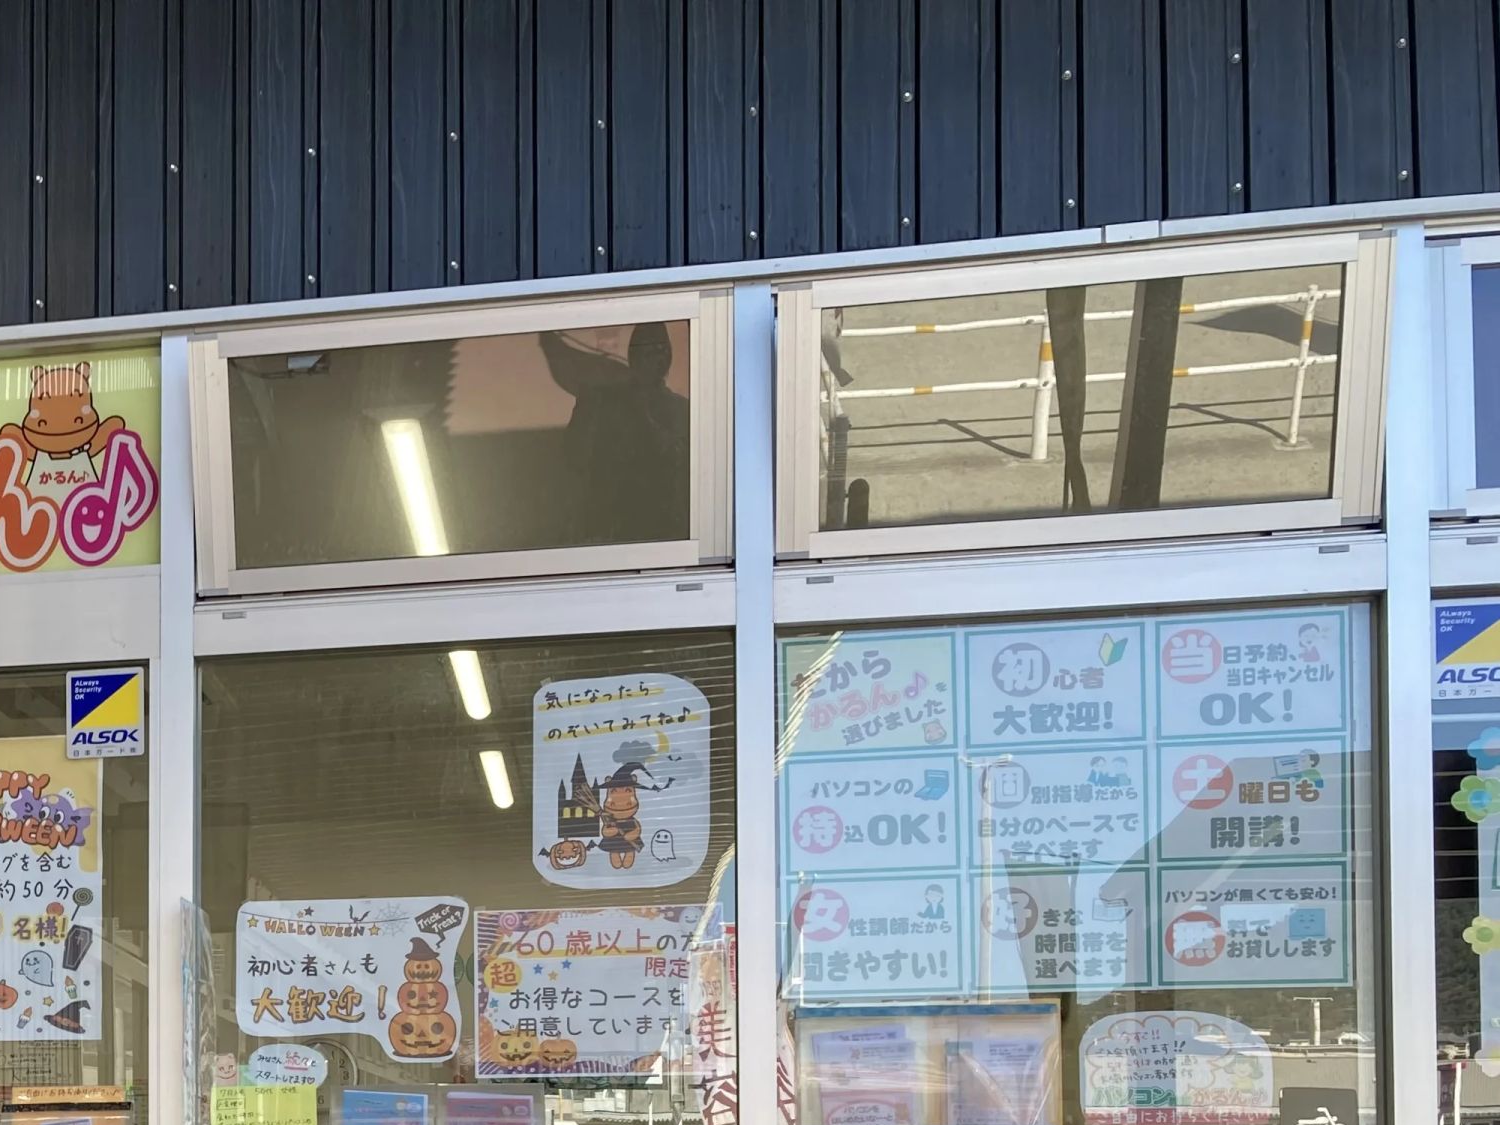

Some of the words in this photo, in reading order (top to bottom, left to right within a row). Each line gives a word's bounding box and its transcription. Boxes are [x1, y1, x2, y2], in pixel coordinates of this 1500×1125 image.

[1441, 617, 1475, 625] Security
[998, 649, 1104, 691] 初心者
[1227, 664, 1333, 687] 当日キャンセル
[545, 681, 651, 711] 気になったら
[993, 702, 1113, 736] 大歓迎!
[1200, 689, 1293, 727] OK!
[841, 700, 947, 745] 選びました
[72, 729, 139, 745] ALSOK
[811, 778, 913, 798] パソコンの
[977, 814, 1138, 837] 自分のペースで
[1210, 816, 1300, 849] 開講!
[1011, 839, 1103, 860] 学べます
[417, 911, 441, 929] Trick
[1034, 932, 1127, 953] 時間帯を
[1227, 938, 1336, 959] お貸しします
[247, 954, 378, 977] 初心者さんも
[490, 962, 518, 989] 超
[644, 957, 690, 978] 限定
[1035, 957, 1127, 979] 選べます
[251, 985, 388, 1024] 大歓迎!
[509, 987, 685, 1010] お得なコースを
[497, 1017, 678, 1037] ご用意しています
